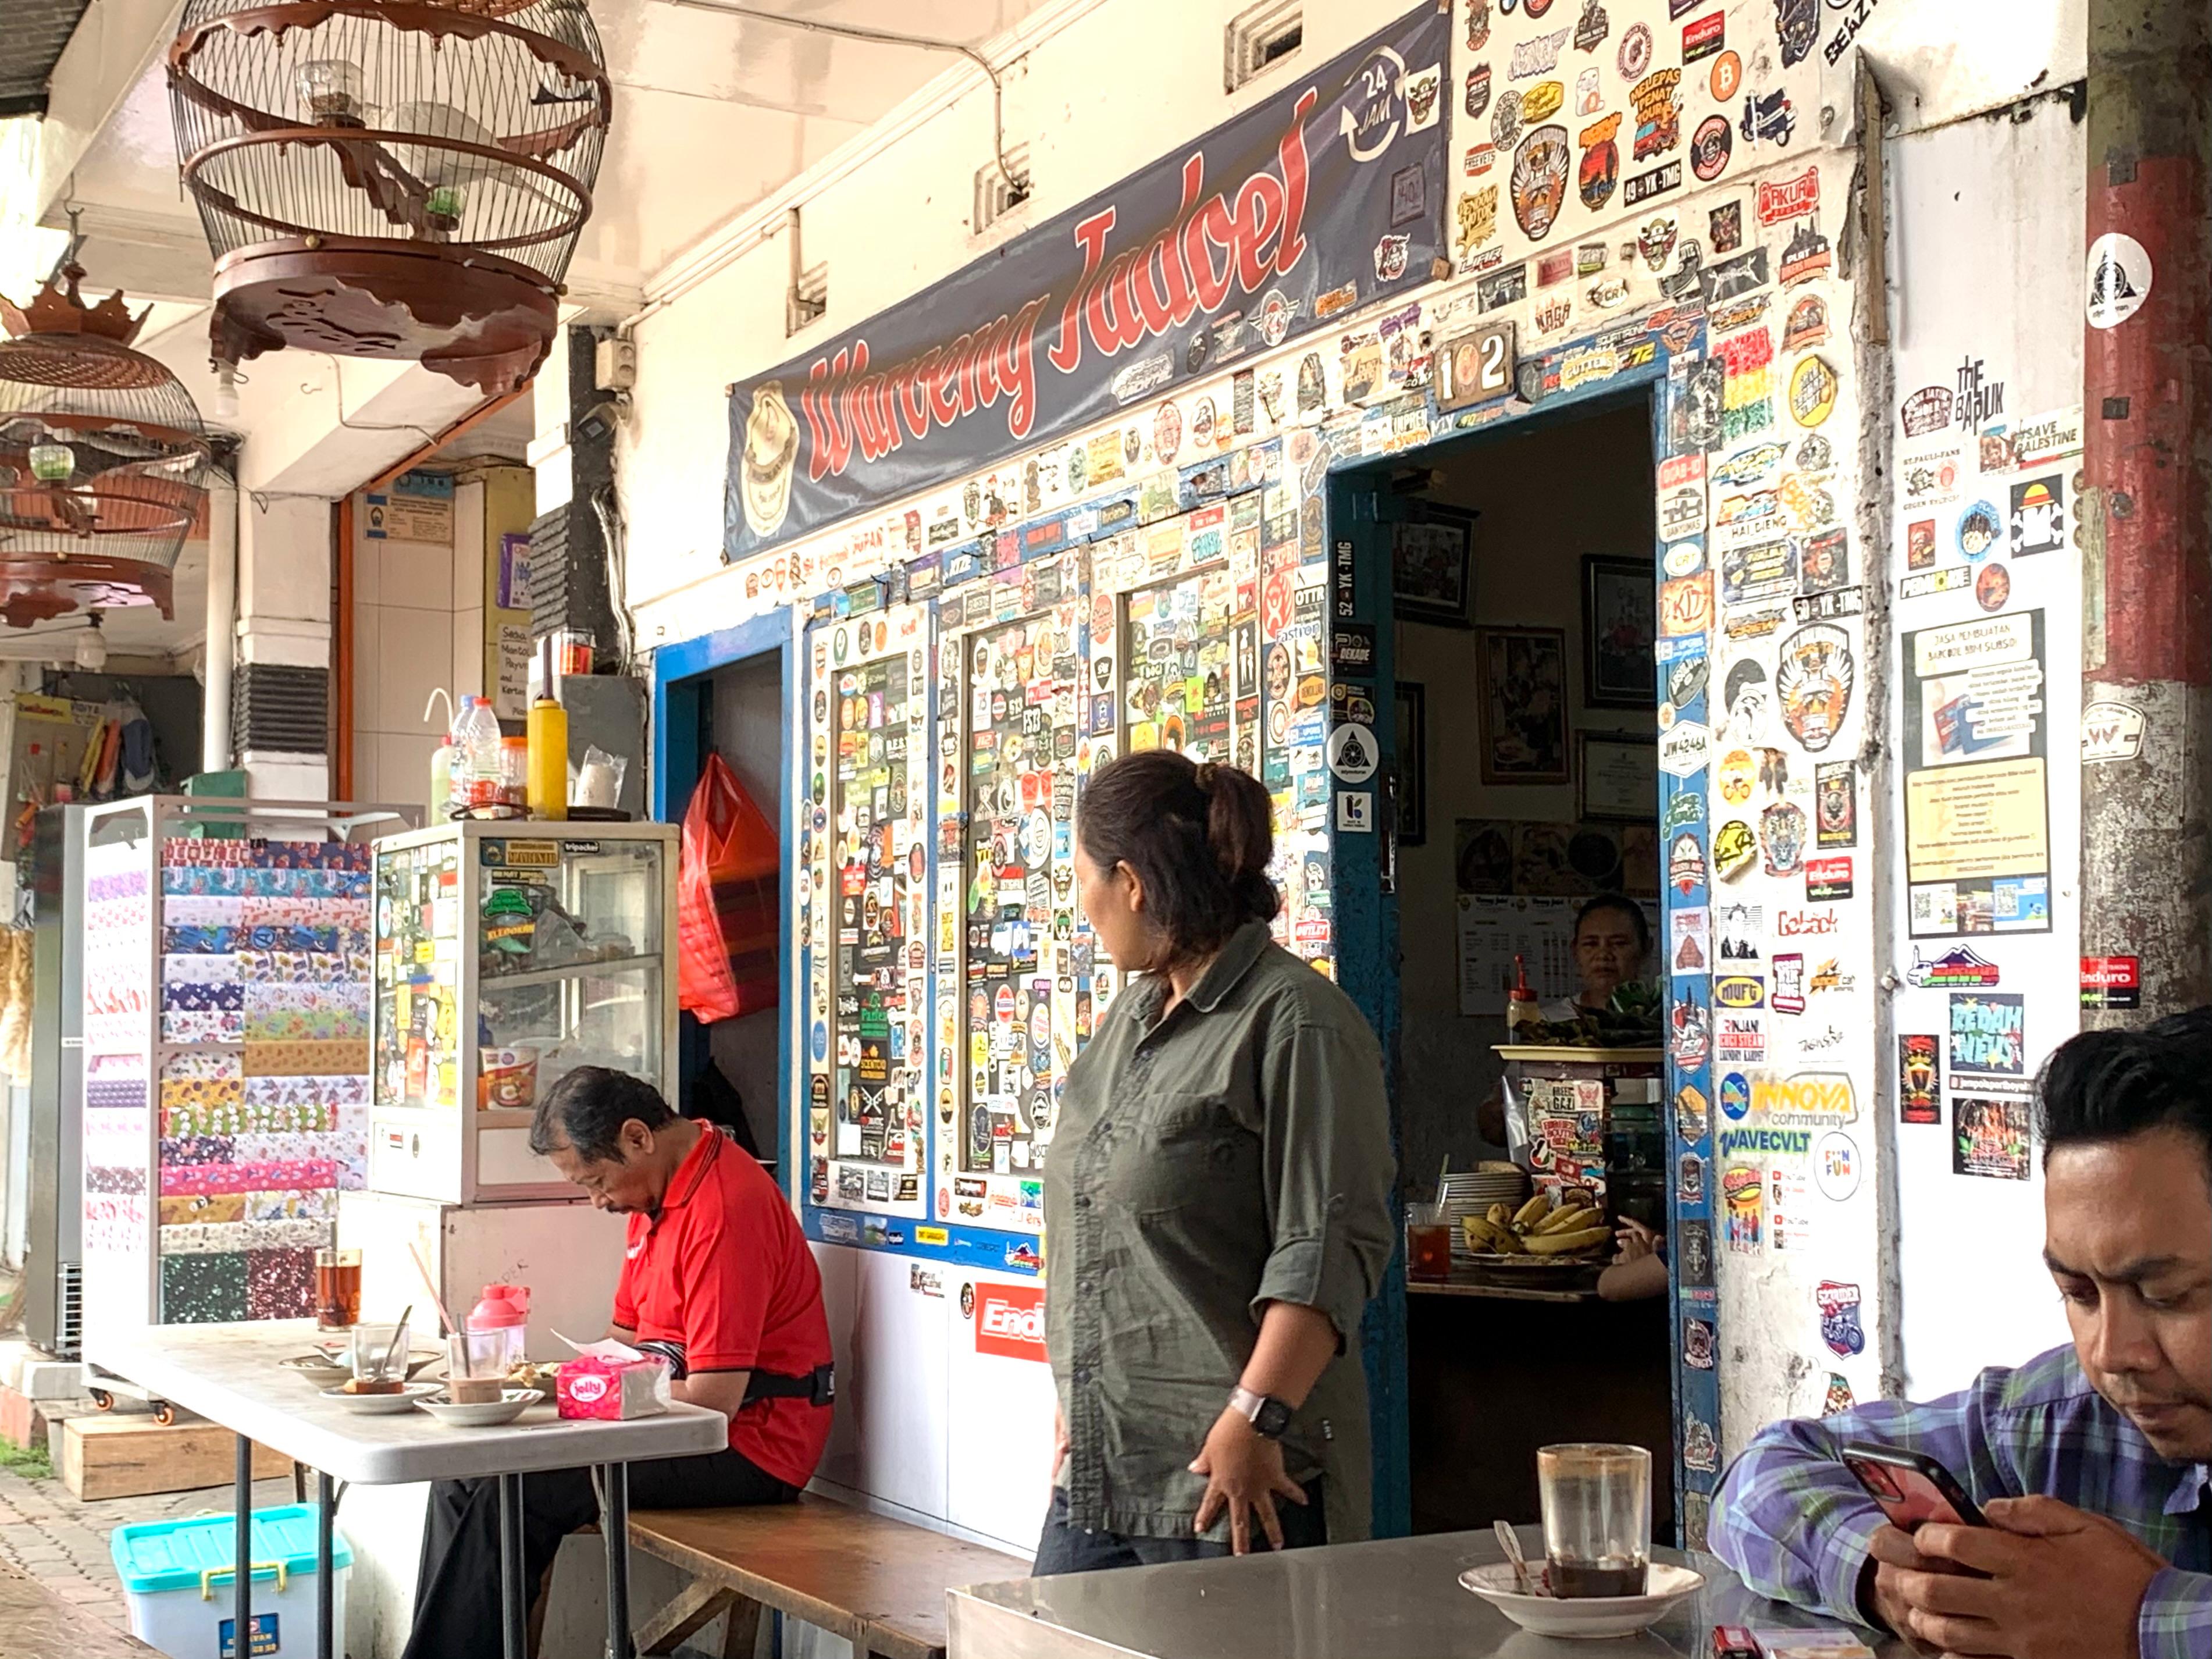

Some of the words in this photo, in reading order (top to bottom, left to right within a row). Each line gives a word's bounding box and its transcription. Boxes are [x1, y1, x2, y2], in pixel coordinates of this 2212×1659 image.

[1686, 24, 1722, 45] Enduro
[1362, 65, 1388, 98] 24
[1630, 69, 1682, 102] MELEPAS
[1637, 86, 1673, 113] PENAT
[1358, 93, 1392, 136] JAM
[1625, 181, 1636, 202] 49
[1645, 175, 1657, 195] YK
[802, 293, 1053, 482] Waroeng
[1049, 87, 1318, 373] Jadoel
[1536, 303, 1572, 330] NAGA
[1441, 334, 1506, 400] 12
[2016, 429, 2078, 453] PALESTINE
[1666, 519, 1701, 537] BANYUMAS
[1338, 572, 1353, 589] YK
[1295, 585, 1325, 606] OTTR
[1338, 601, 1353, 617] 52
[1276, 622, 1320, 643] Fastron
[1935, 632, 1956, 646] JASA
[1958, 625, 2011, 640] PEMBUATAN
[1340, 647, 1371, 661] DEKADE
[565, 842, 600, 852] tripacker
[1808, 869, 1849, 881] Enduro
[2081, 971, 2131, 983] Enduro
[1719, 1034, 1739, 1048] CUCI
[1739, 1034, 1764, 1048] STEAM
[1752, 1080, 1851, 1112] INNOVA
[1772, 1113, 1845, 1129] community
[1719, 1130, 1812, 1158] WAVECVLT
[573, 1379, 602, 1396] jolly
